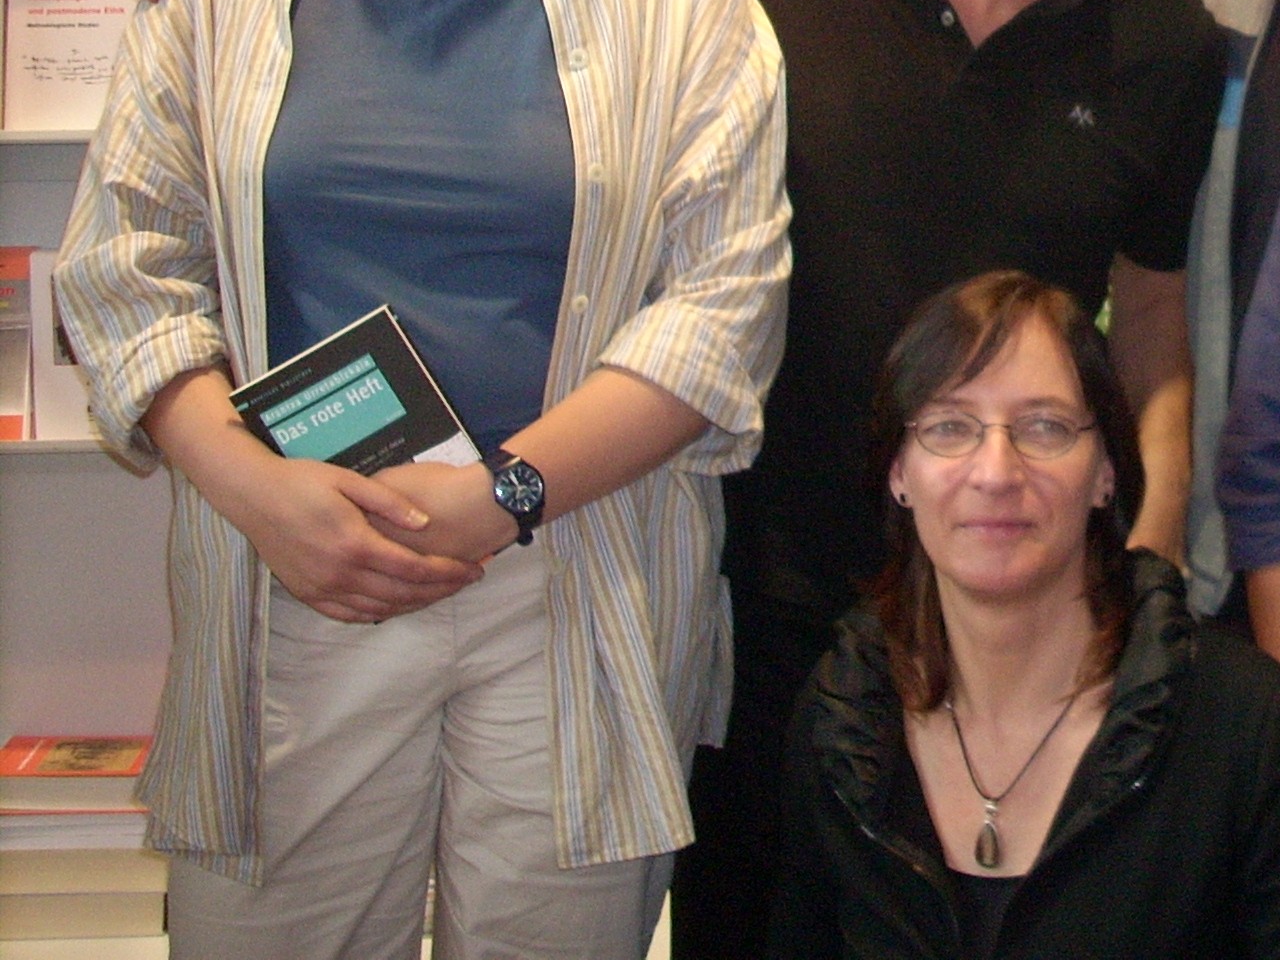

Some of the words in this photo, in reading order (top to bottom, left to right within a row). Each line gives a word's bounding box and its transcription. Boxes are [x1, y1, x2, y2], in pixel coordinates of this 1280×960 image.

[275, 421, 309, 445] Das
[309, 401, 345, 428] rote
[345, 376, 384, 406] Heft
